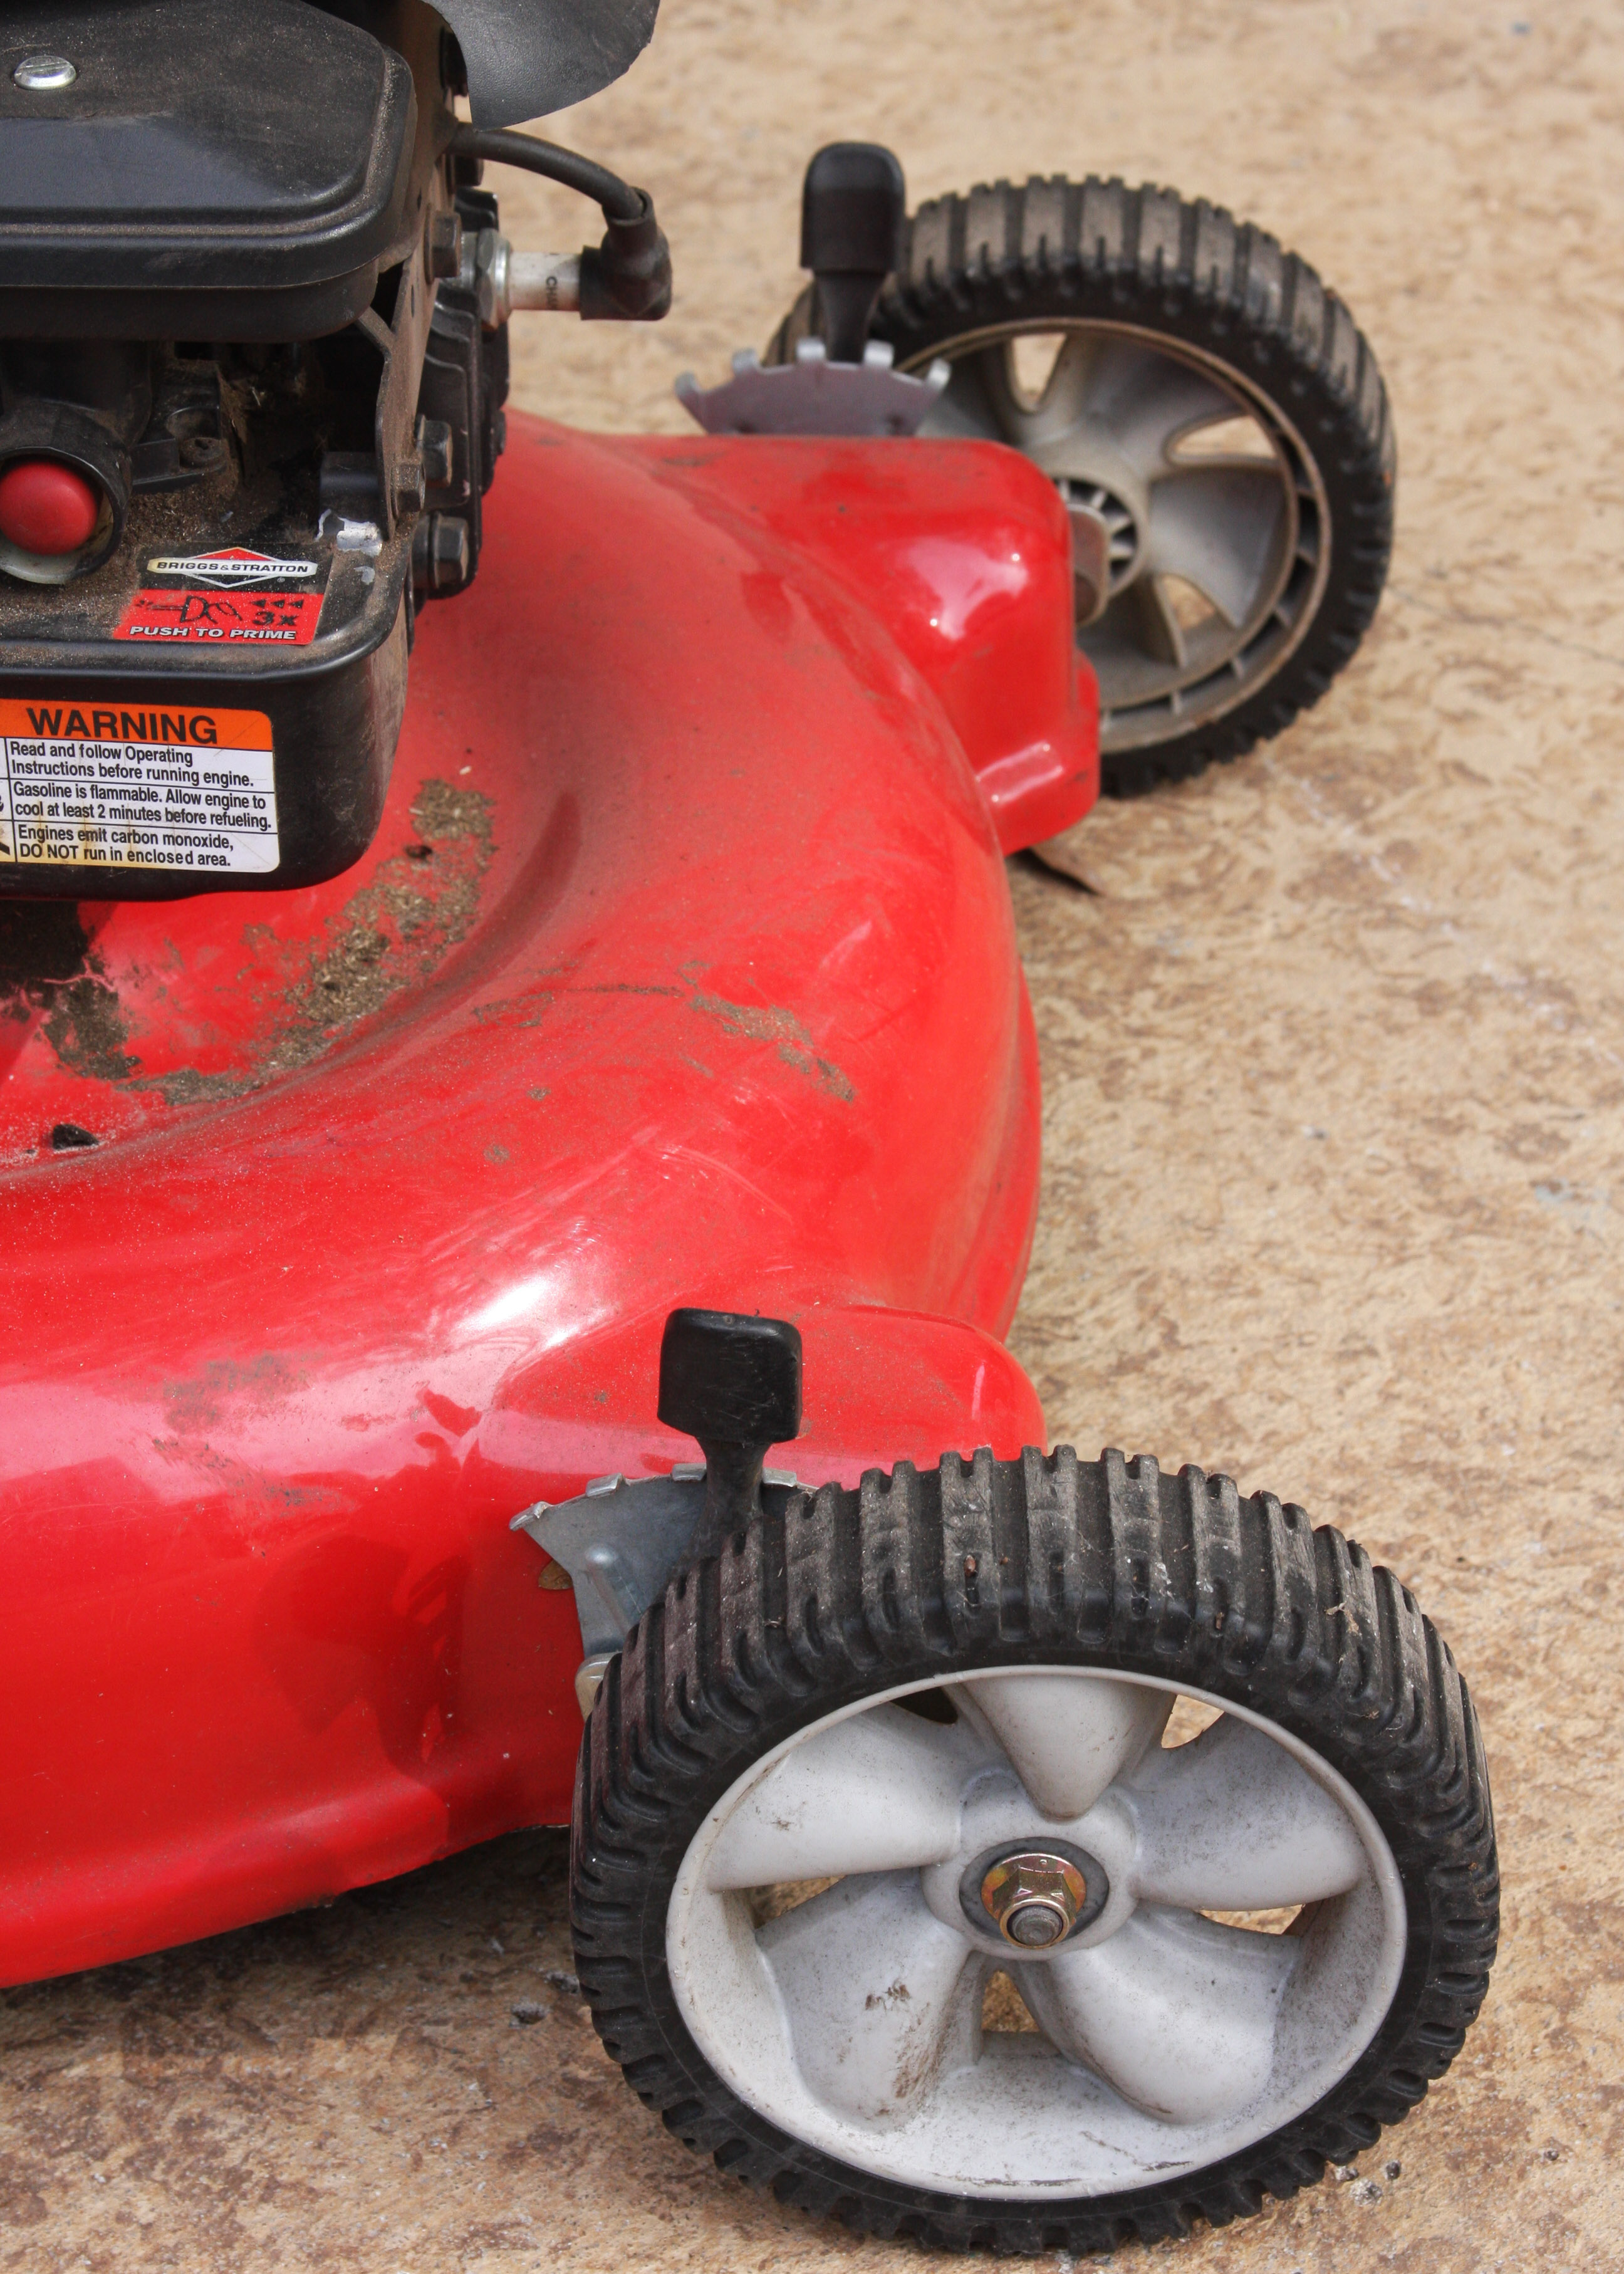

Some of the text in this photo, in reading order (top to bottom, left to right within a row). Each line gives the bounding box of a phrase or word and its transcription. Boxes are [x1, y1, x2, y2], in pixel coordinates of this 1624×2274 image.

[130, 626, 296, 640] PUSH TO PRIME
[26, 707, 217, 744] WARNING
[10, 741, 193, 767] Read and follow Operating
[11, 760, 254, 788] Instructions before running engine.
[13, 781, 266, 810] Gasoline is flammable. Allow engine to
[15, 801, 272, 831] cool at least 2 minutes before refueling.
[18, 825, 234, 852] Engines emit carbon monoxide,
[20, 844, 231, 867] DO NOT run in enclosed area.
